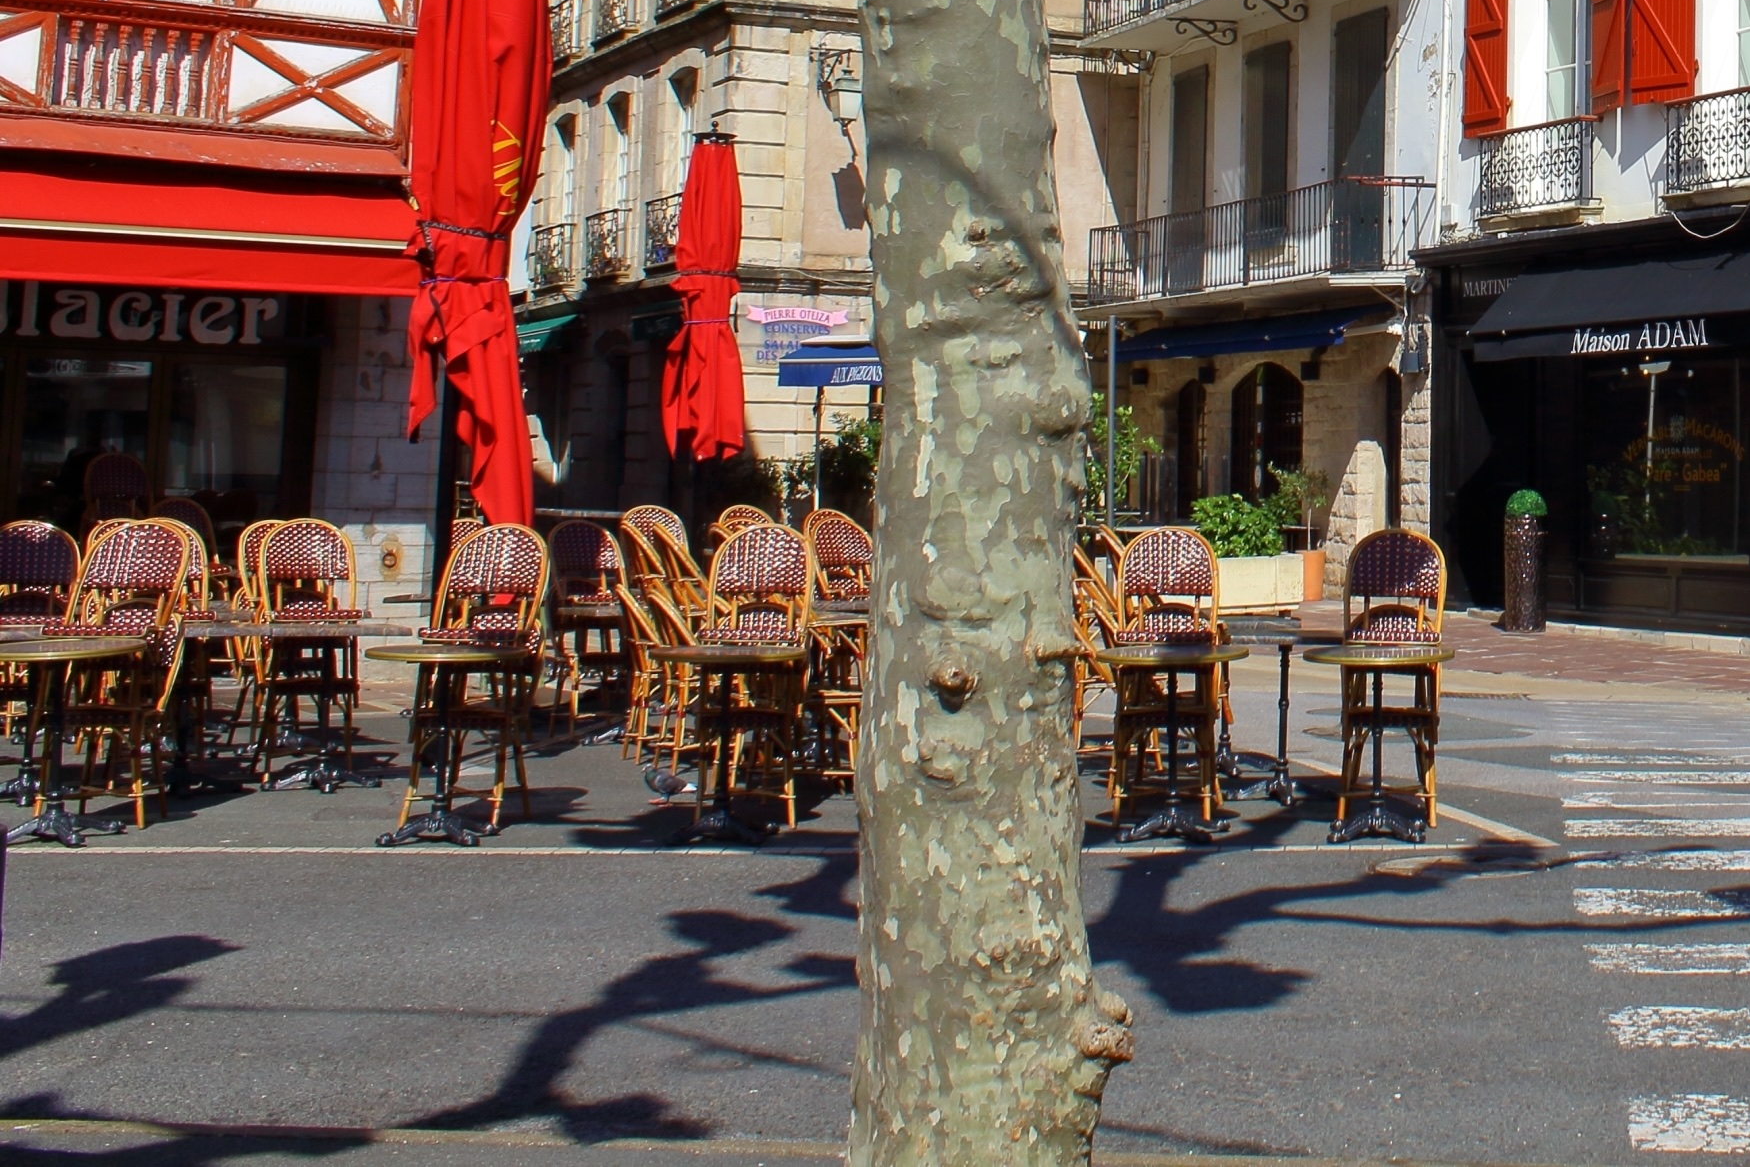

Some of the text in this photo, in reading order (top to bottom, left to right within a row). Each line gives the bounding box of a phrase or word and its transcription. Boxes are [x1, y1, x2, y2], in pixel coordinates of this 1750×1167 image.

[1463, 277, 1517, 297] MARTINE
[765, 309, 831, 324] PIERRE OTEIZA
[764, 323, 831, 335] CONSERVES
[1570, 318, 1709, 354] Maison ADAM
[764, 339, 801, 351] SALAI
[756, 350, 778, 360] DES
